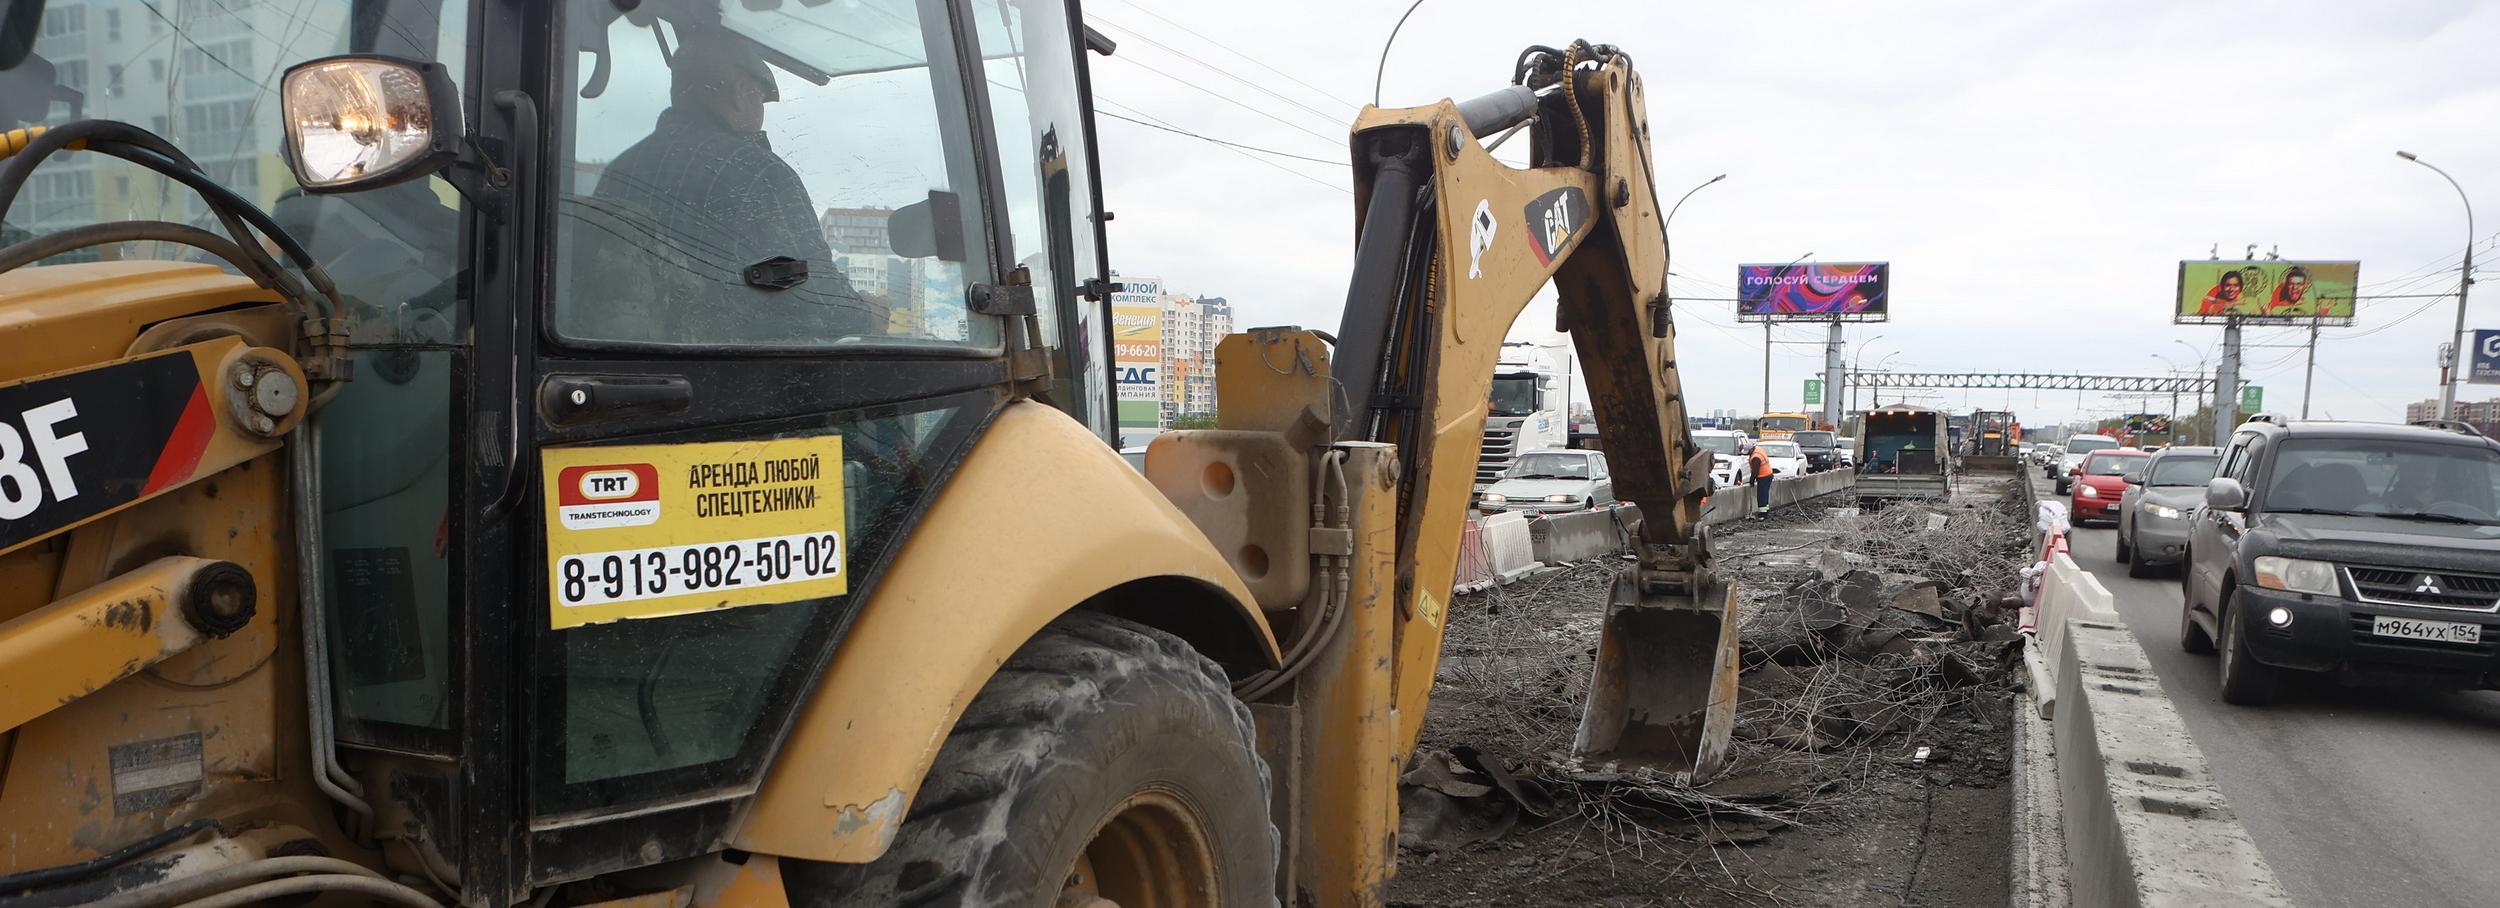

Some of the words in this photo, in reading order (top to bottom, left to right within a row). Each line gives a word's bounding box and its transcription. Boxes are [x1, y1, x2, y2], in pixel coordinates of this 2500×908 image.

[1544, 191, 1571, 255] CAT
[1747, 274, 1808, 285] ГОЛОСУЙ
[1814, 274, 1878, 284] СЕРДЦЕМ
[1122, 281, 1157, 294] ИЛОЙ
[1111, 294, 1156, 303] КОМПЛЕКС
[689, 461, 760, 489] АРЕНДА
[763, 453, 820, 484] ЛЮБОЙ
[590, 476, 628, 492] TRT
[696, 485, 816, 518] СПЕЦТЕХНИКИ
[568, 508, 652, 521] TRANSTECHNOLOGY
[563, 534, 837, 602] 8-913-982-50-02
[2450, 624, 2478, 638] 154
